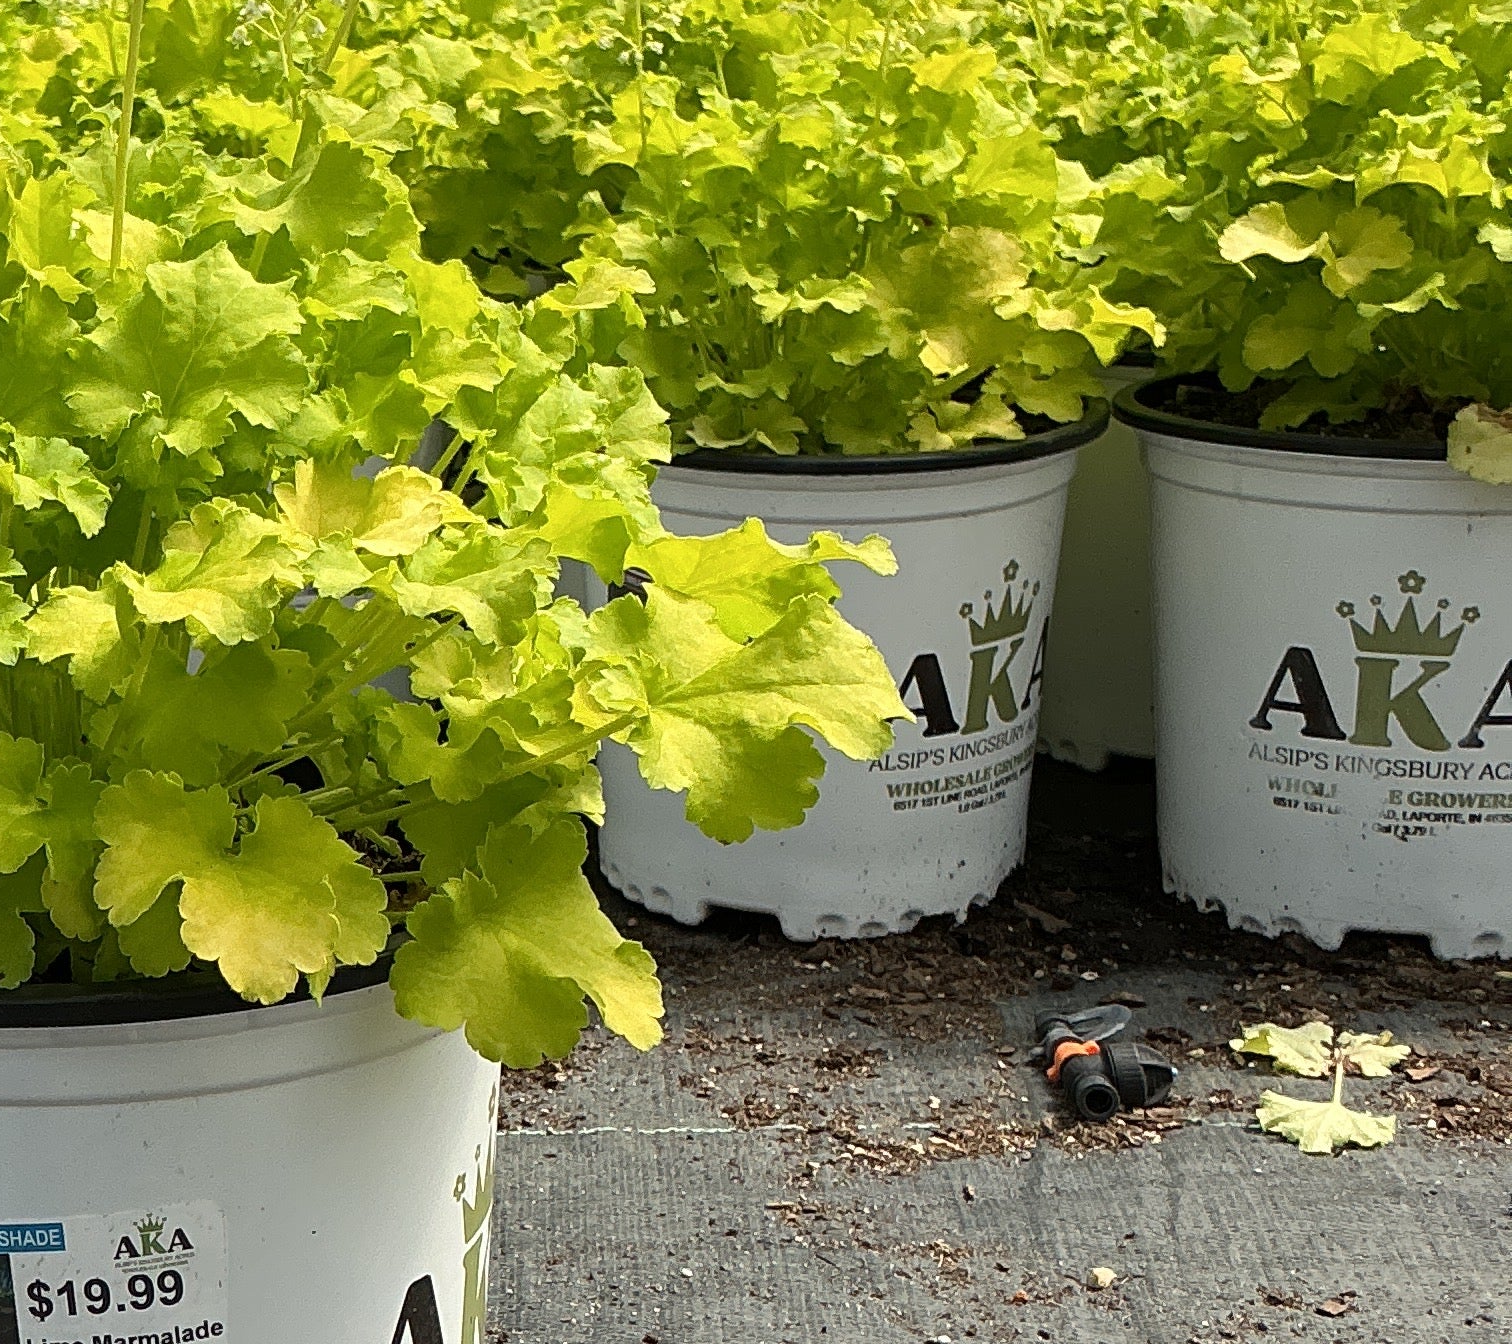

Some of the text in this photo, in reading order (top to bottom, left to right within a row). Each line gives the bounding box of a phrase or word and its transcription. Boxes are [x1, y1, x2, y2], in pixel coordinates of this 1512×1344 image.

[868, 748, 945, 773] ALSIP'S
[1248, 742, 1329, 771] ALSIP'S
[1335, 753, 1475, 781] KINGSBURY
[886, 766, 993, 799] WHOLESALE
[114, 1227, 195, 1260] AKA
[26, 1269, 185, 1323] $19.99
